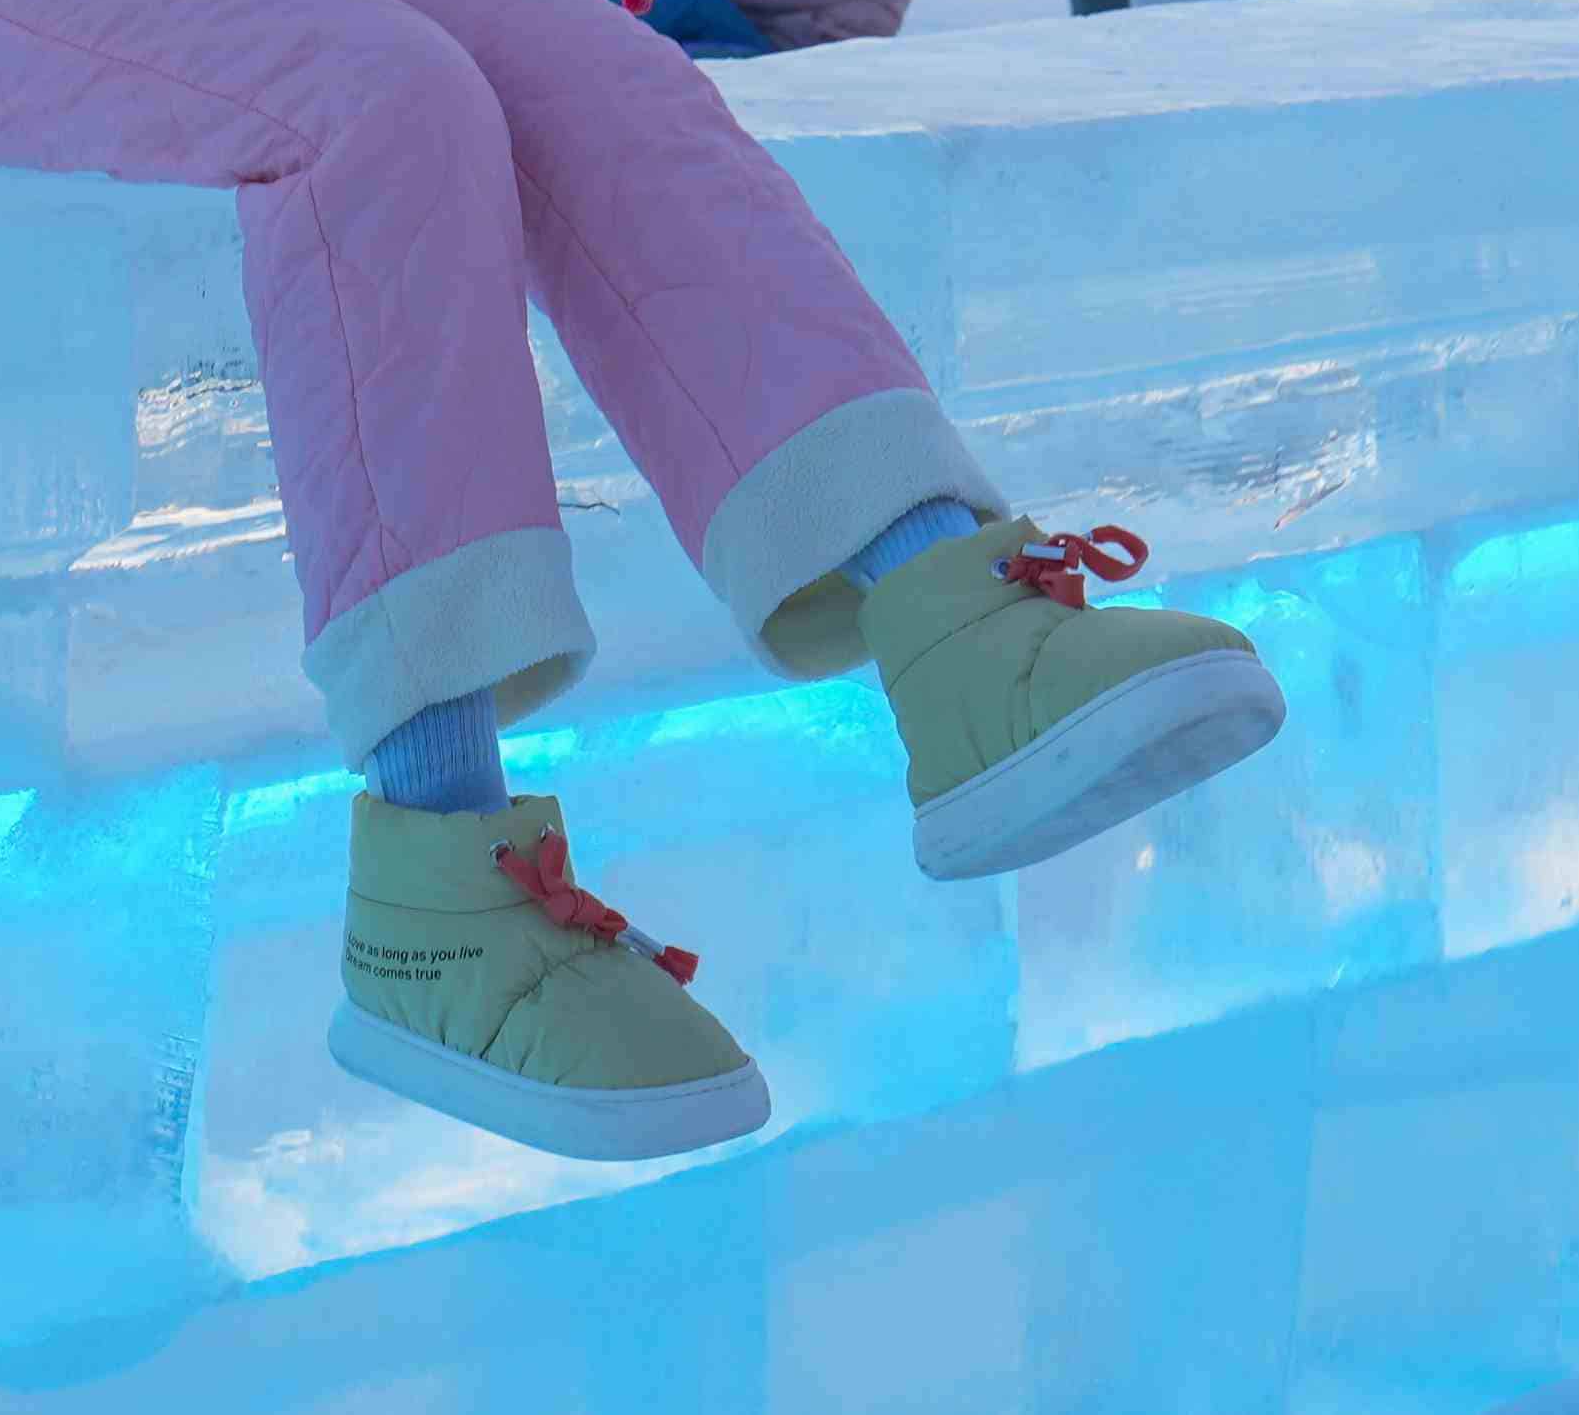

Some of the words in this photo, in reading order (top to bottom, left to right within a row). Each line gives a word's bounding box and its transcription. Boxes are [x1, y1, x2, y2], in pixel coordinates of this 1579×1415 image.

[367, 945, 379, 956] as
[381, 946, 409, 964] long
[411, 950, 426, 962] as
[430, 949, 457, 965] you
[458, 945, 484, 959] live
[373, 964, 412, 980] comes
[415, 968, 442, 981] true
